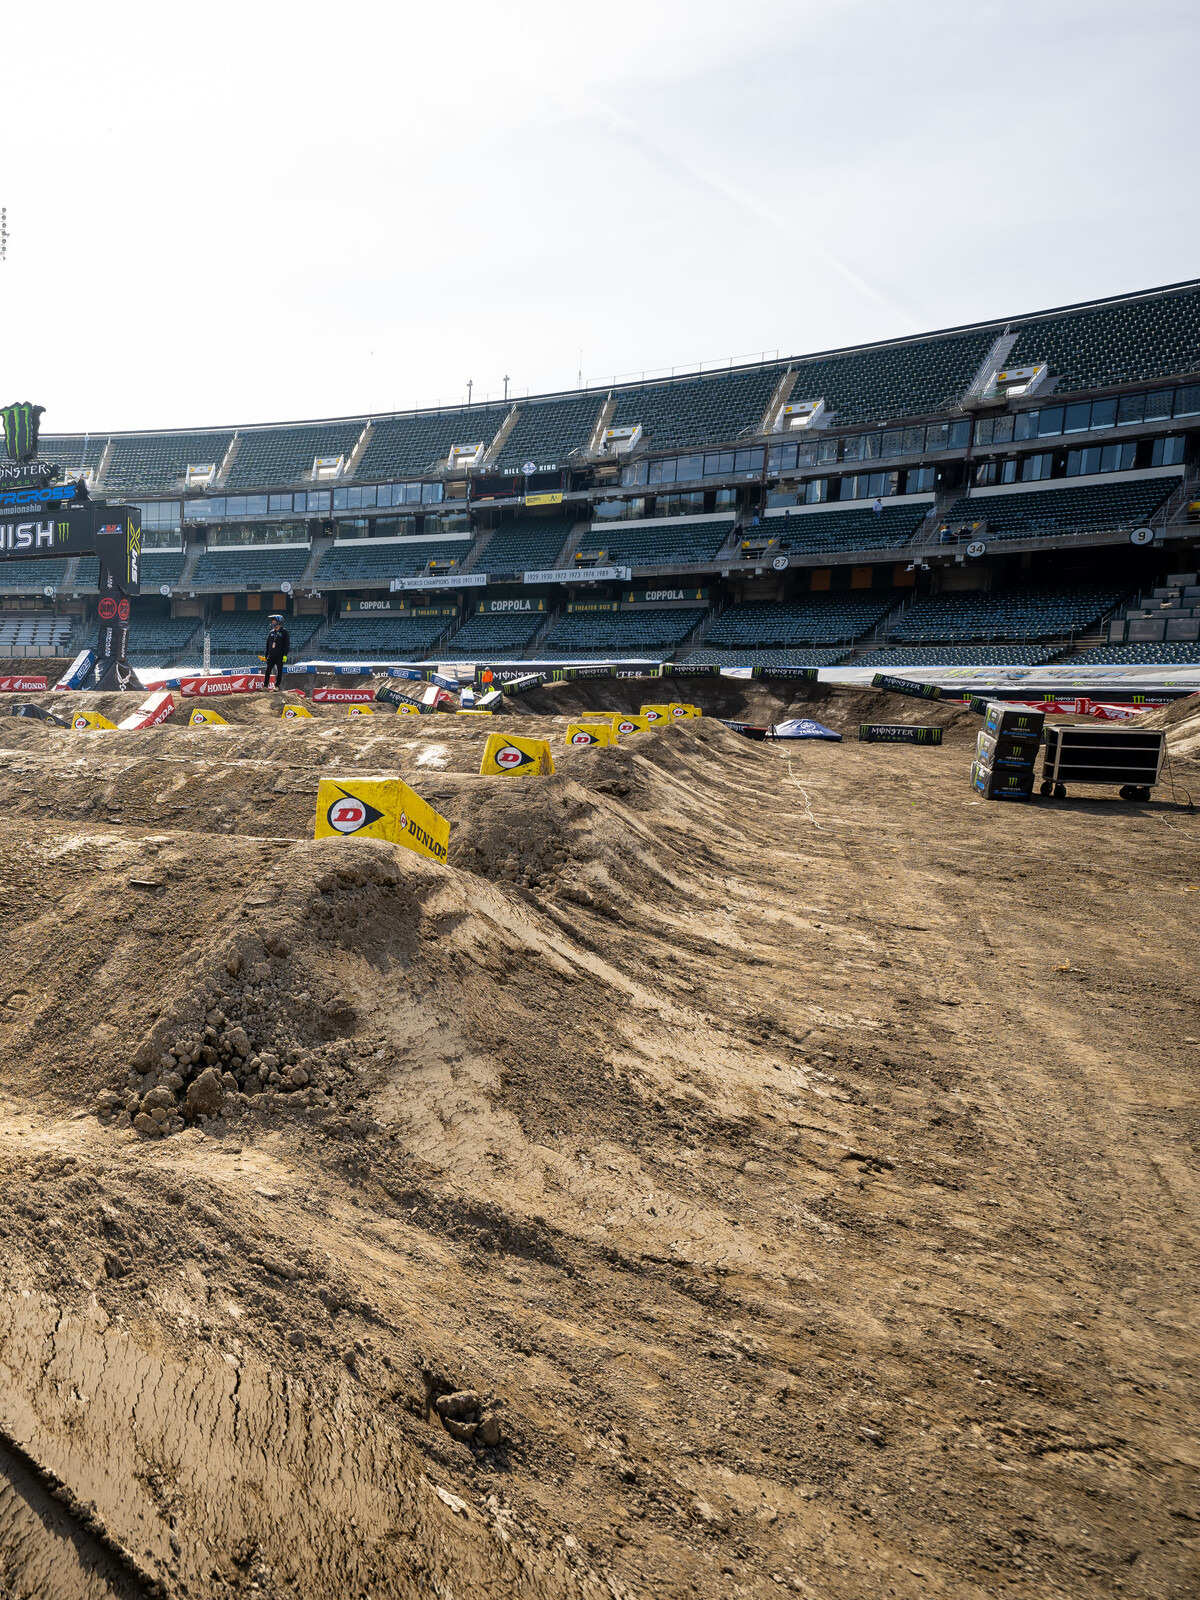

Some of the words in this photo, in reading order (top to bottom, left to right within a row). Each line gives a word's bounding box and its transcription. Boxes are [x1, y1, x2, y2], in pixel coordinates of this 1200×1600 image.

[504, 467, 519, 475] BILL
[1138, 532, 1146, 540] 9
[968, 545, 983, 554] 34
[774, 559, 786, 568] 27
[527, 573, 539, 581] 1929
[424, 578, 449, 586] CHAMPIONS
[645, 590, 684, 600] COPPOLA
[360, 600, 390, 610] COPPOLA
[491, 600, 531, 610] COPPOLA
[77, 657, 91, 680] WPS
[393, 670, 409, 678] WPS
[21, 682, 47, 690] HONDA
[518, 678, 538, 688] MONSTER
[884, 676, 920, 691] MONSTER
[208, 684, 232, 693] HONDA
[388, 692, 422, 710] MONSTER
[872, 727, 914, 736] MONSTER
[499, 752, 520, 762] D
[333, 808, 362, 822] D
[408, 820, 447, 860] DUNLOP
